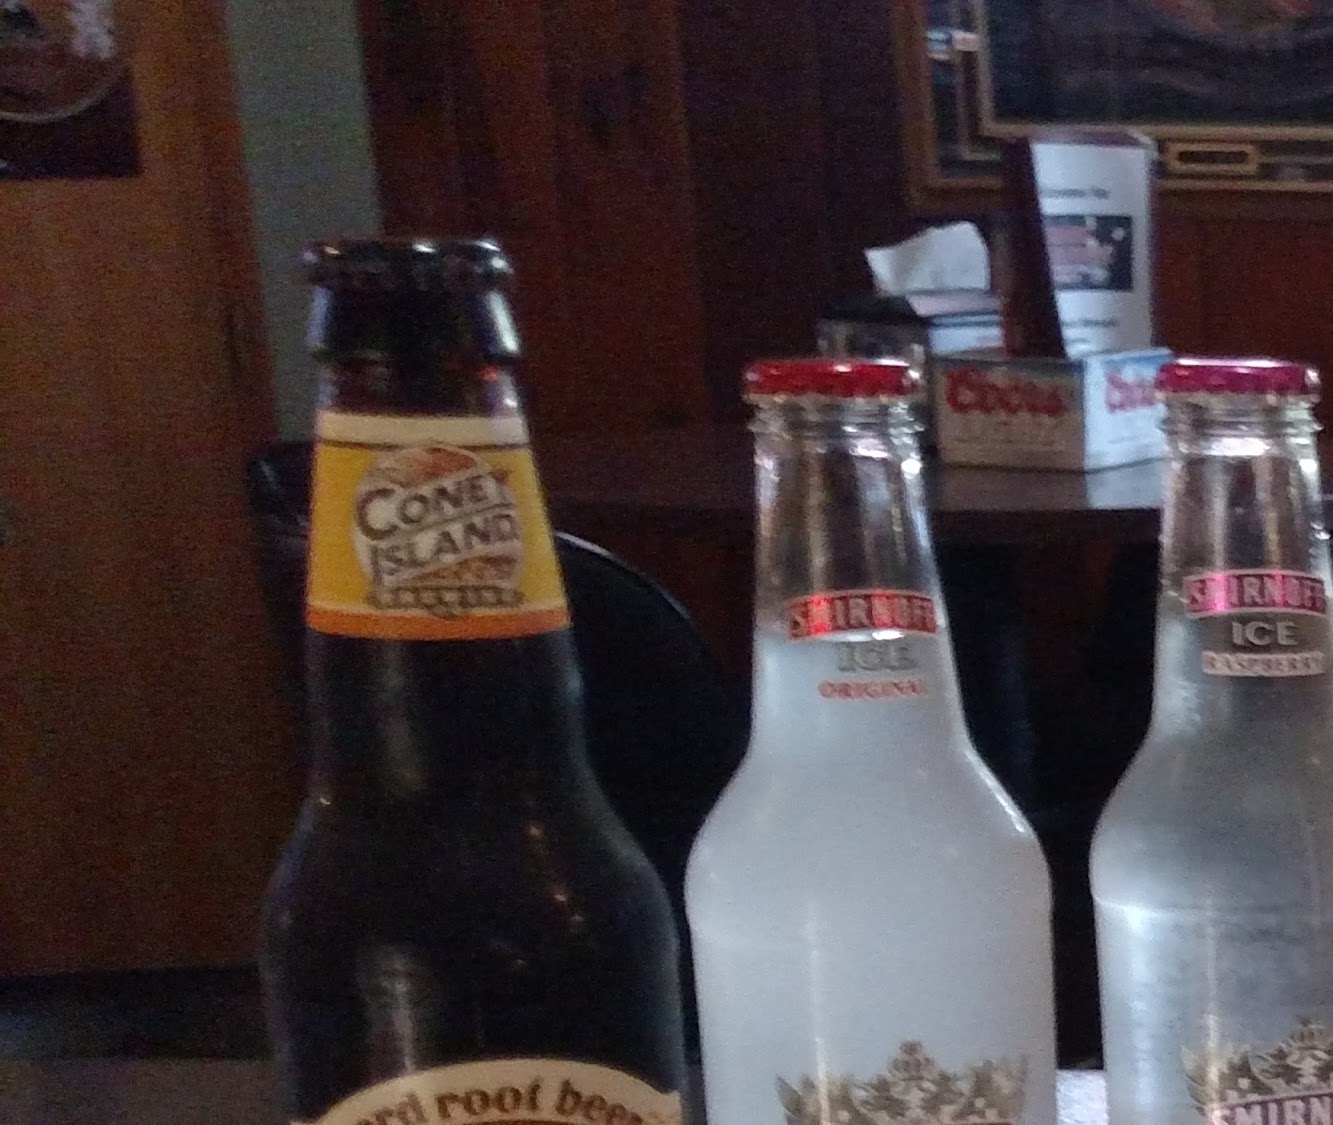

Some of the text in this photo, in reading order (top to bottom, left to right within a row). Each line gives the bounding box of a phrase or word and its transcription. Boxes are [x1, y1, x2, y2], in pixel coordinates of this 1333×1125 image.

[357, 469, 512, 541] CONEY
[371, 514, 518, 587] ISLAND
[1231, 620, 1299, 647] ICE
[838, 645, 918, 673] ICE
[436, 1074, 545, 1123] root
